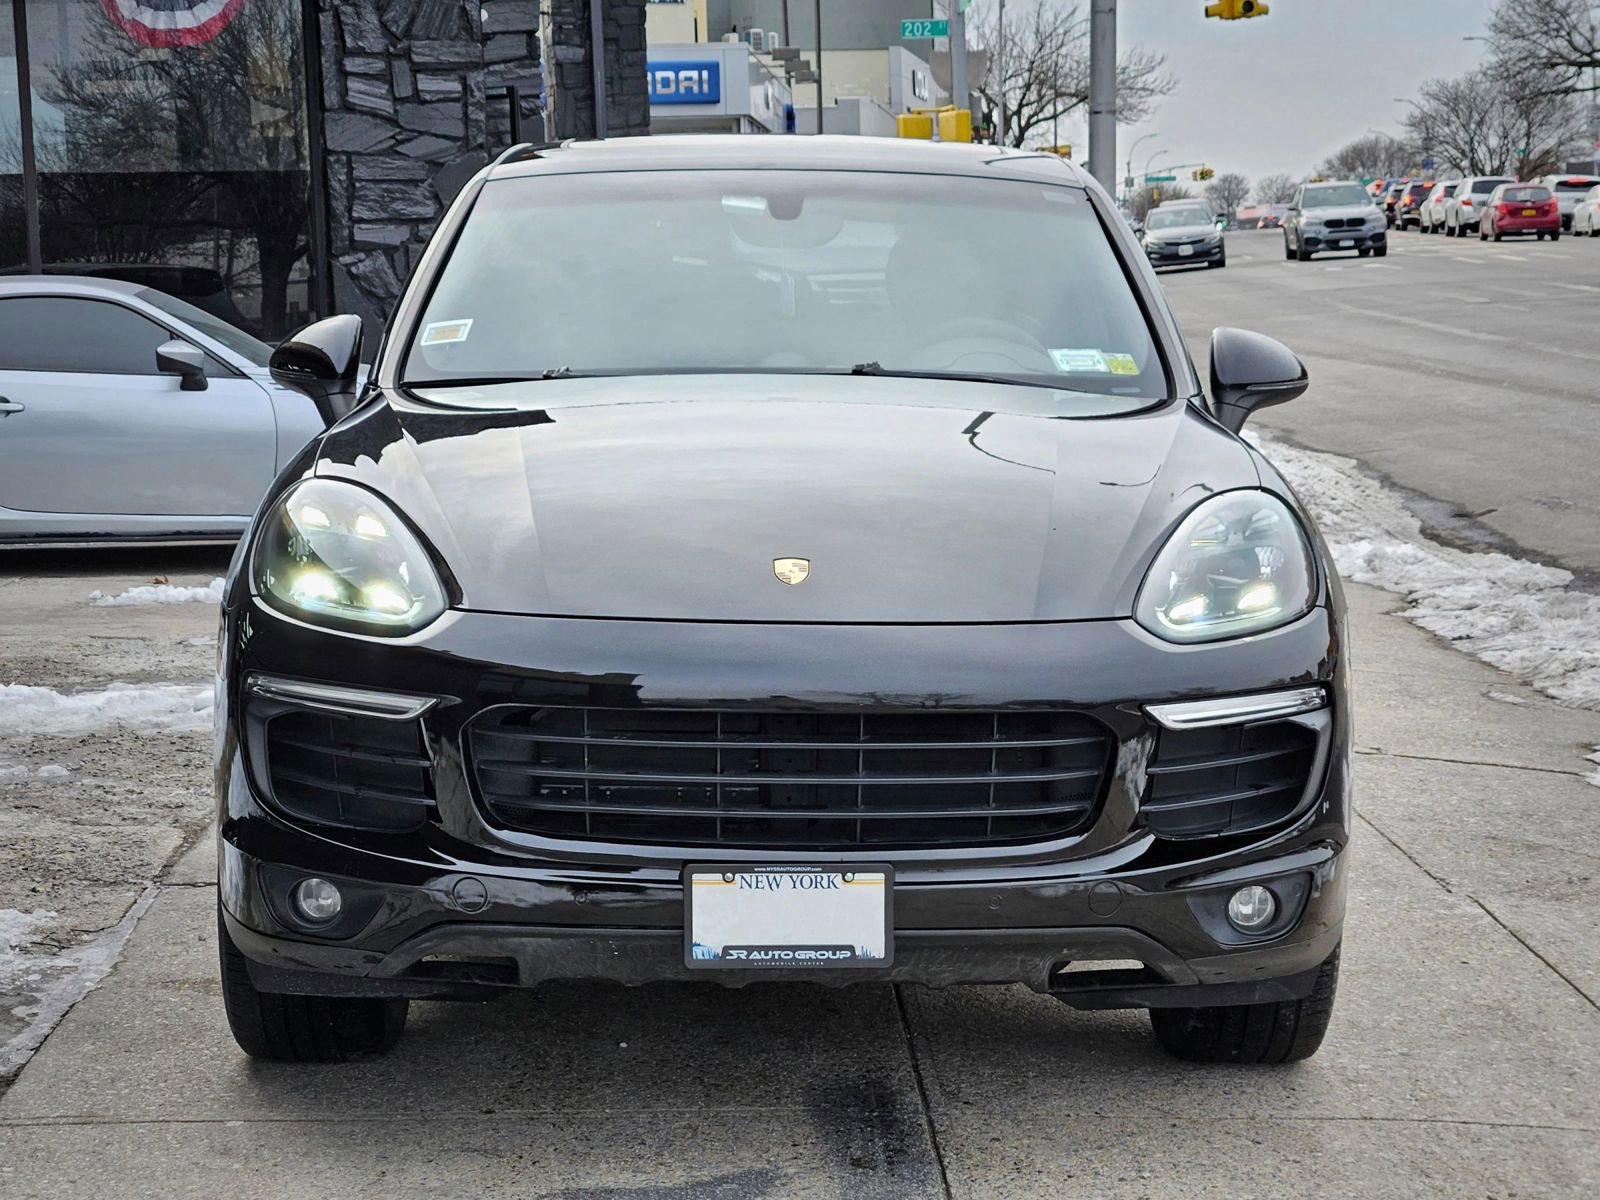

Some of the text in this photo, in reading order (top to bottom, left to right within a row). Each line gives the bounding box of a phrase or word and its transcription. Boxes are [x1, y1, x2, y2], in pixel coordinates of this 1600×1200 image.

[905, 22, 931, 36] 202
[740, 874, 840, 891] NEW YORK
[795, 950, 851, 959] GROUP
